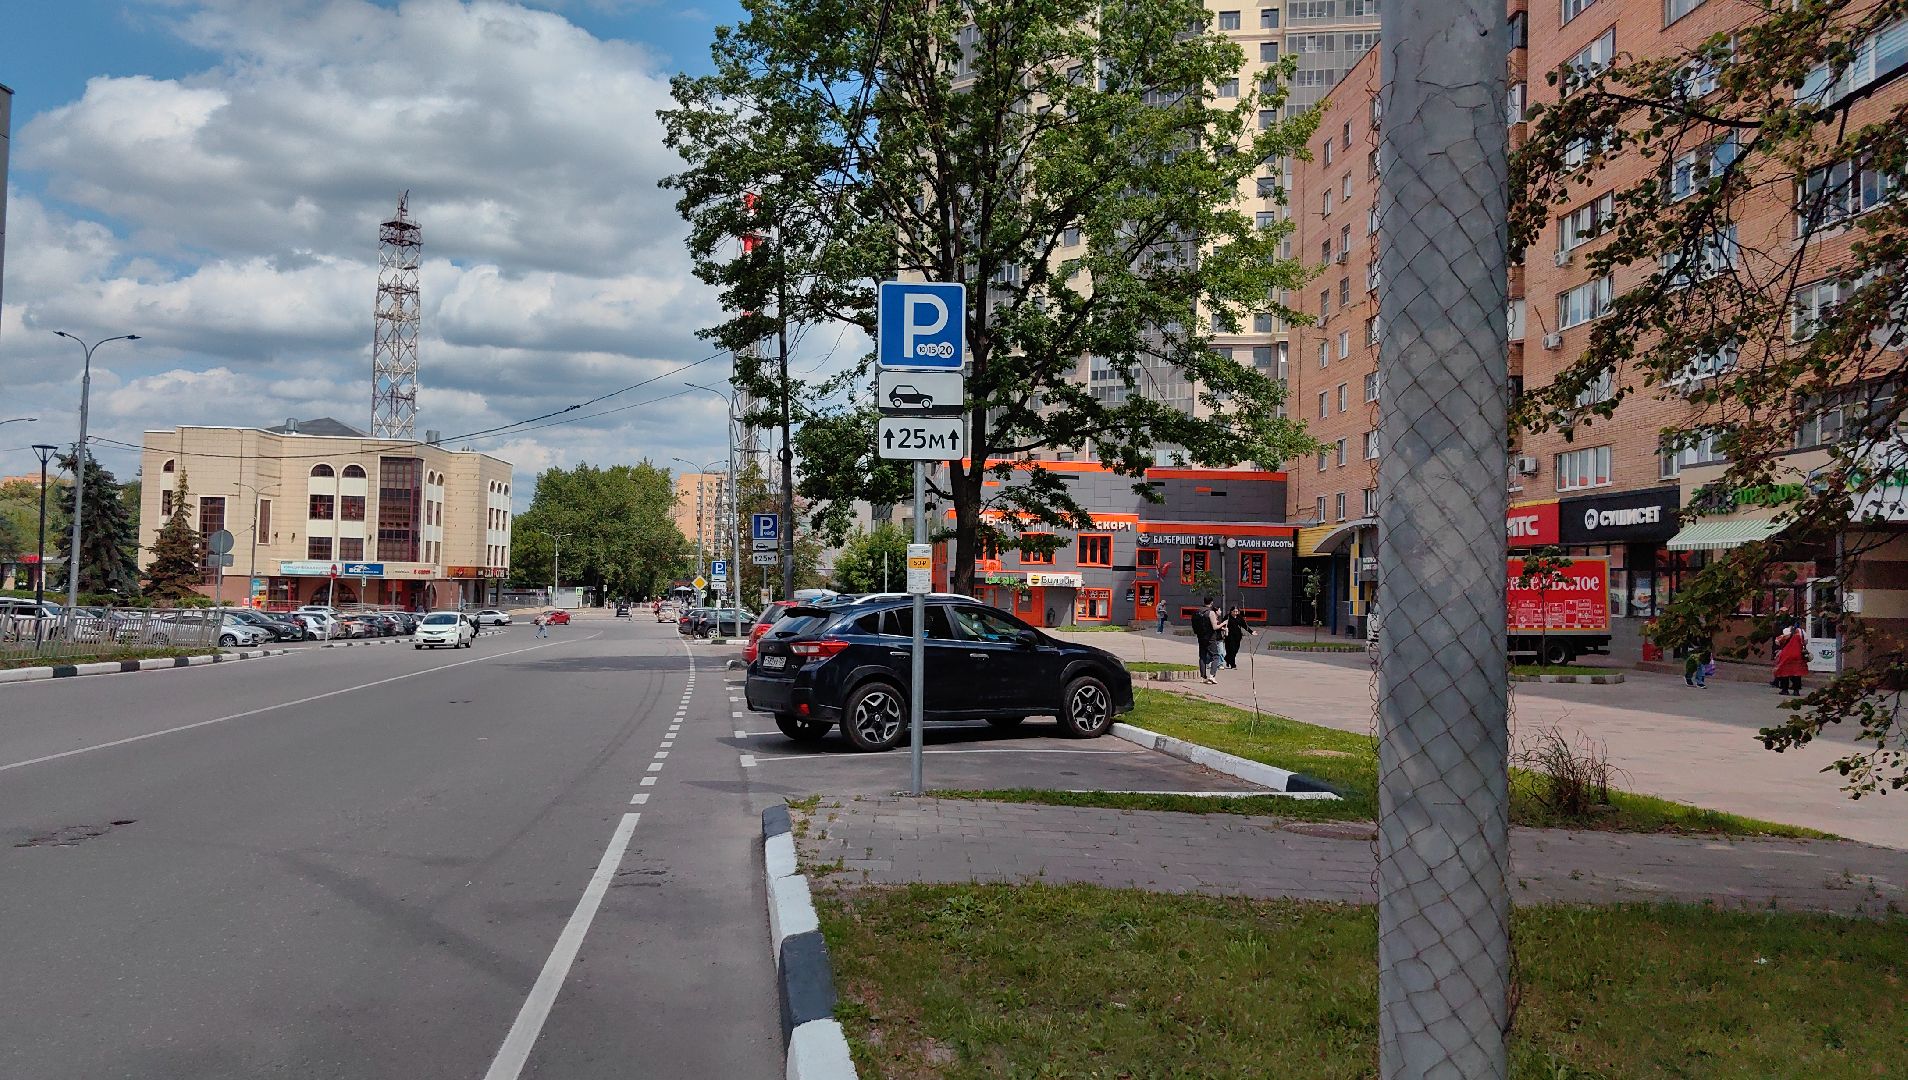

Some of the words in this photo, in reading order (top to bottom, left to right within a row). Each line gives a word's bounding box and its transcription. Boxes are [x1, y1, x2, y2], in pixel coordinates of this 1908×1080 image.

[904, 293, 949, 358] P
[939, 345, 953, 356] 20
[1600, 506, 1662, 526] СУШИСЕТ
[760, 516, 774, 537] P
[1153, 535, 1196, 545] БАРБЕРШОП
[1198, 535, 1214, 547] 312
[1237, 538, 1261, 547] САЛОН
[1261, 540, 1294, 548] КРАСОТЫ
[715, 562, 724, 574] P
